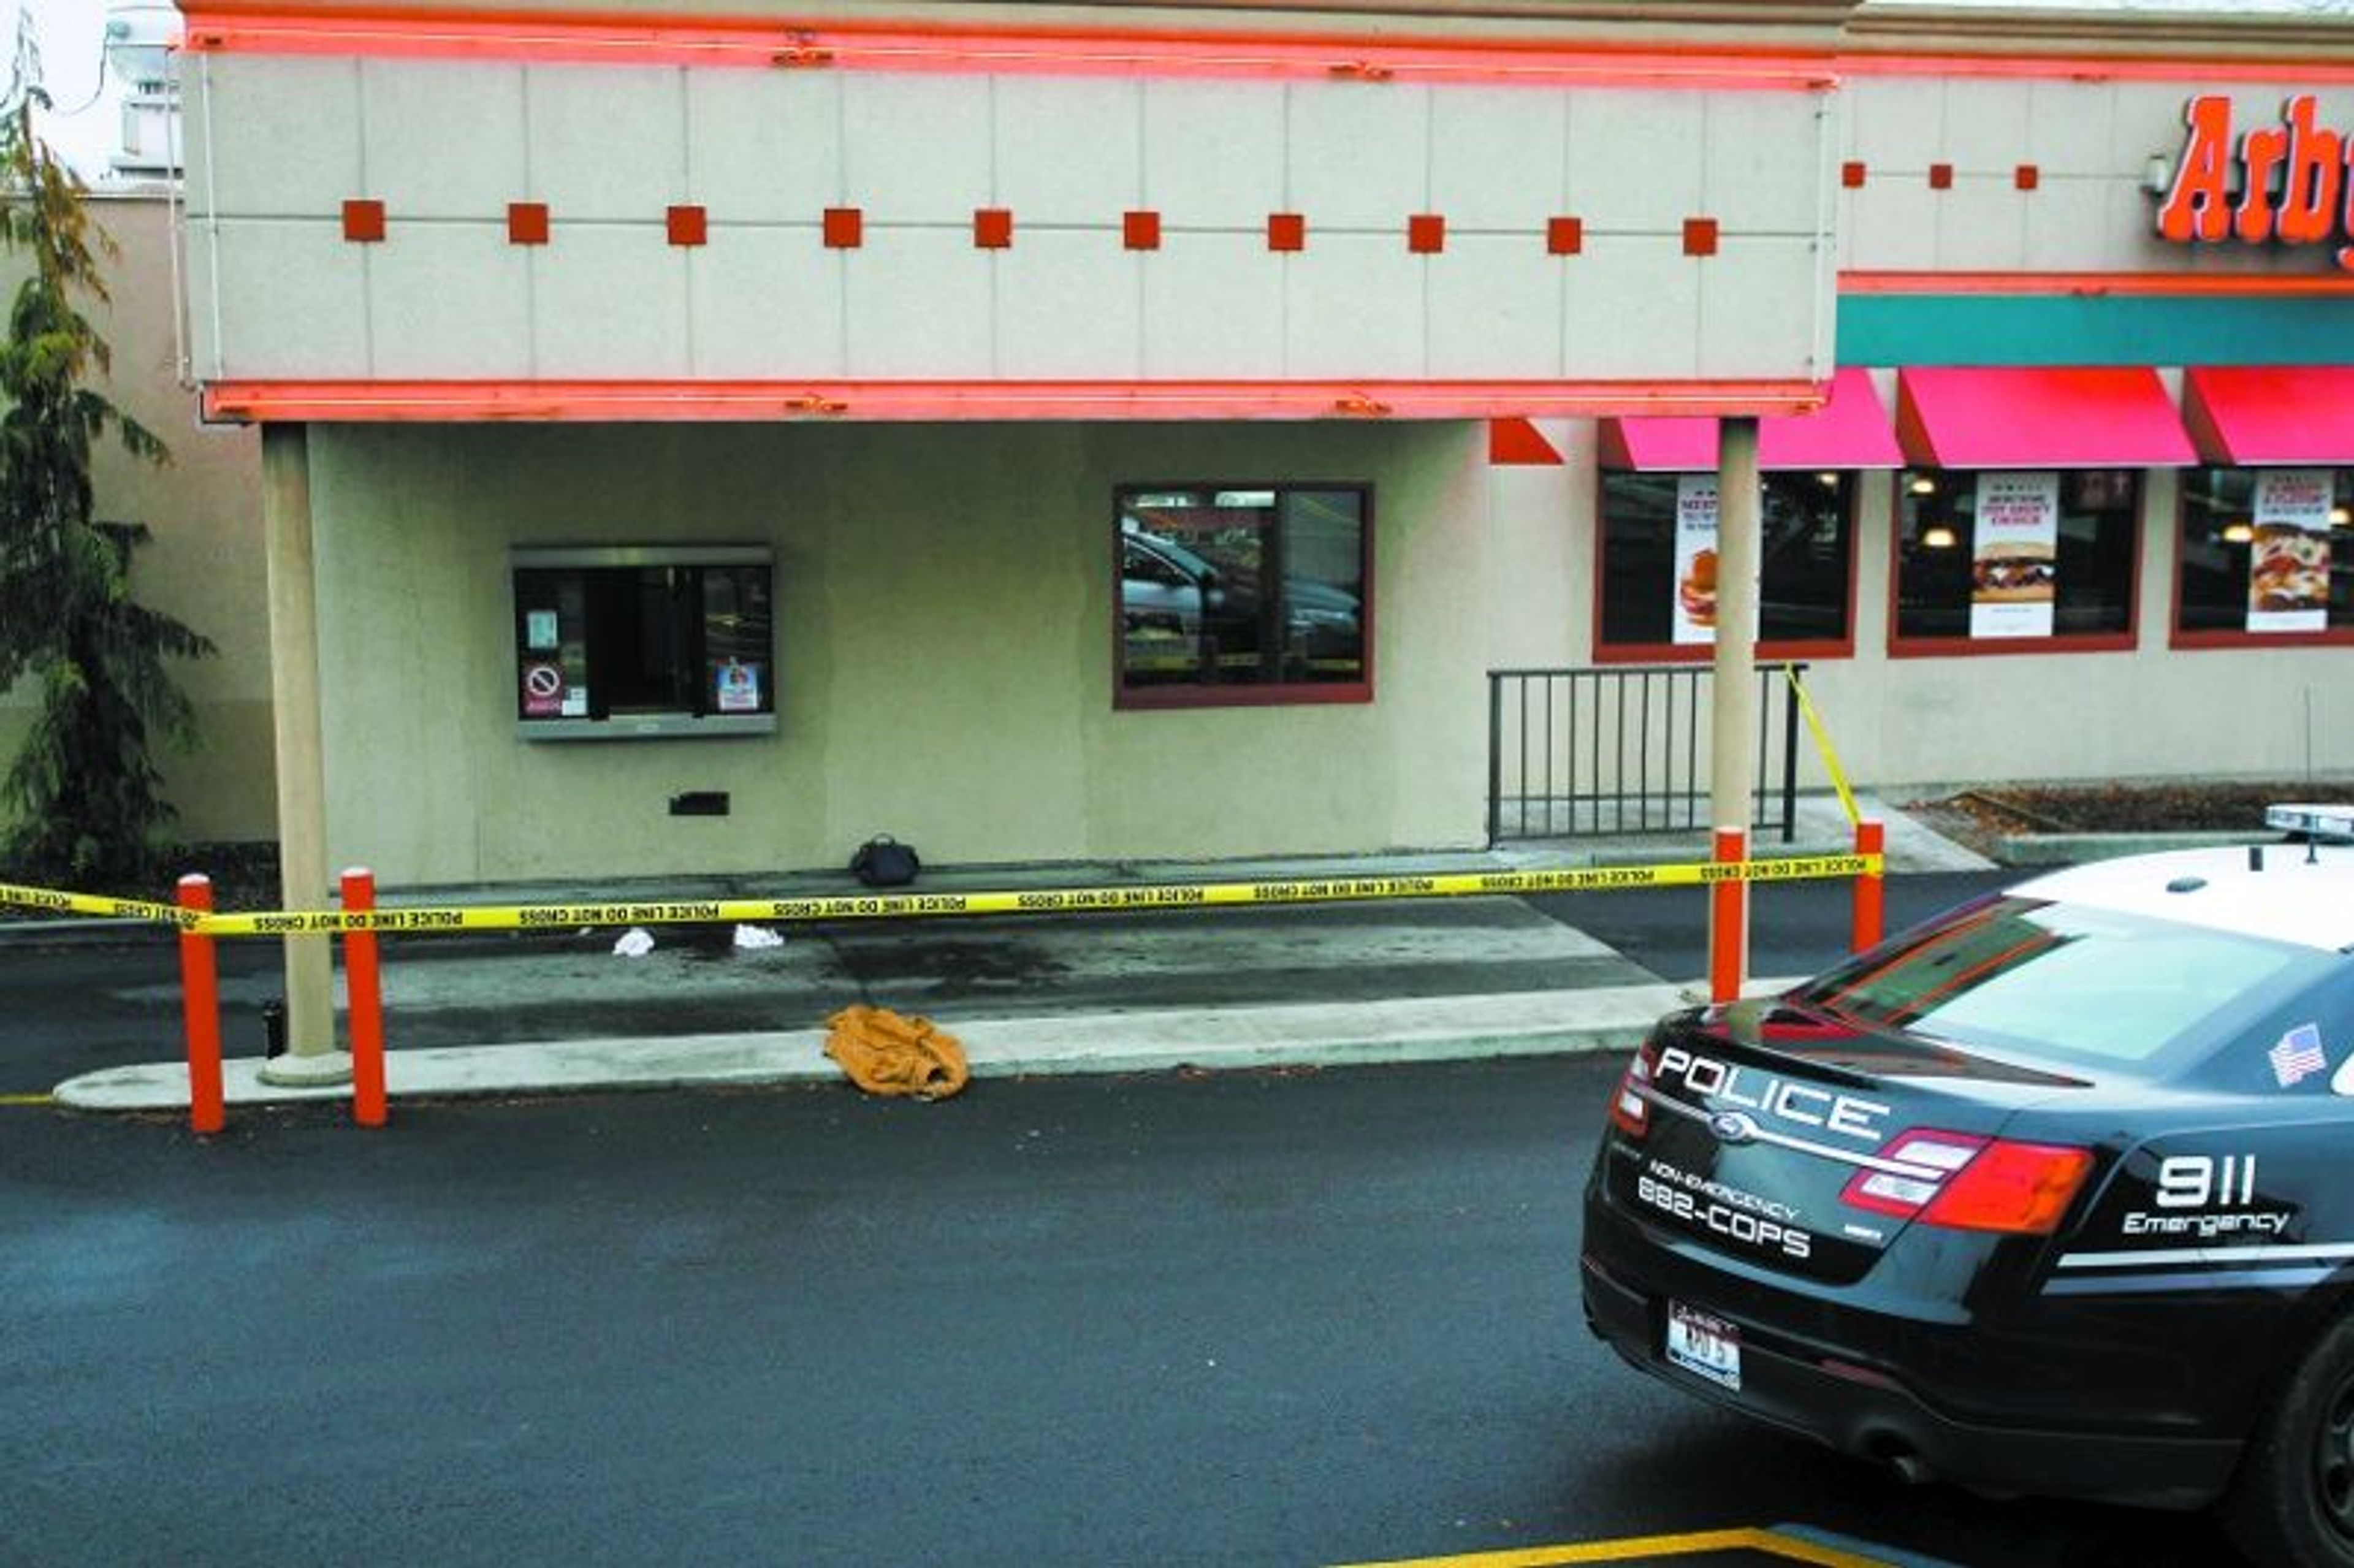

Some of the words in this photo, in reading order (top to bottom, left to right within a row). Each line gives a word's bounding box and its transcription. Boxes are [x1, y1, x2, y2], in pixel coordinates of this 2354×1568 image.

[1745, 864, 1770, 877] NOT
[1772, 862, 1790, 875] DO
[1794, 861, 1823, 875] LINE
[1824, 858, 1867, 872] POLICE
[1527, 873, 1555, 887] NOT
[1556, 872, 1574, 886] DO
[1577, 870, 1607, 885] LINE
[1609, 868, 1655, 882] POLICE
[1700, 866, 1740, 880] CROSS
[1302, 881, 1329, 896] NOT
[1333, 881, 1351, 895] DO
[1354, 879, 1386, 894] LINE
[1388, 878, 1434, 892] POLICE
[1480, 874, 1523, 889] CROSS
[1100, 891, 1119, 905] DO
[1123, 889, 1154, 904] LINE
[1156, 888, 1205, 902] POLICE
[1254, 883, 1299, 899] CROSS
[858, 899, 878, 913] DO
[882, 897, 914, 913] LINE
[918, 896, 966, 911] POLICE
[1018, 893, 1064, 908] CROSS
[1067, 892, 1096, 906] NOT
[573, 907, 602, 921] NOT
[606, 907, 628, 921] DO
[630, 905, 663, 919] LINE
[668, 904, 719, 919] POLICE
[773, 901, 821, 916] CROSS
[827, 900, 855, 914] NOT
[309, 915, 341, 929] NOT
[346, 915, 366, 928] DO
[373, 913, 405, 927] LINE
[409, 911, 463, 926] POLICE
[518, 907, 569, 924] CROSS
[253, 916, 304, 931] CROSS
[1655, 1046, 1890, 1140] POLICE
[2155, 1150, 2255, 1207] 911
[1649, 1159, 1800, 1220] NON-EMERGENCY
[1638, 1176, 1811, 1258] 882-COPS
[2122, 1211, 2290, 1237] Emergency
